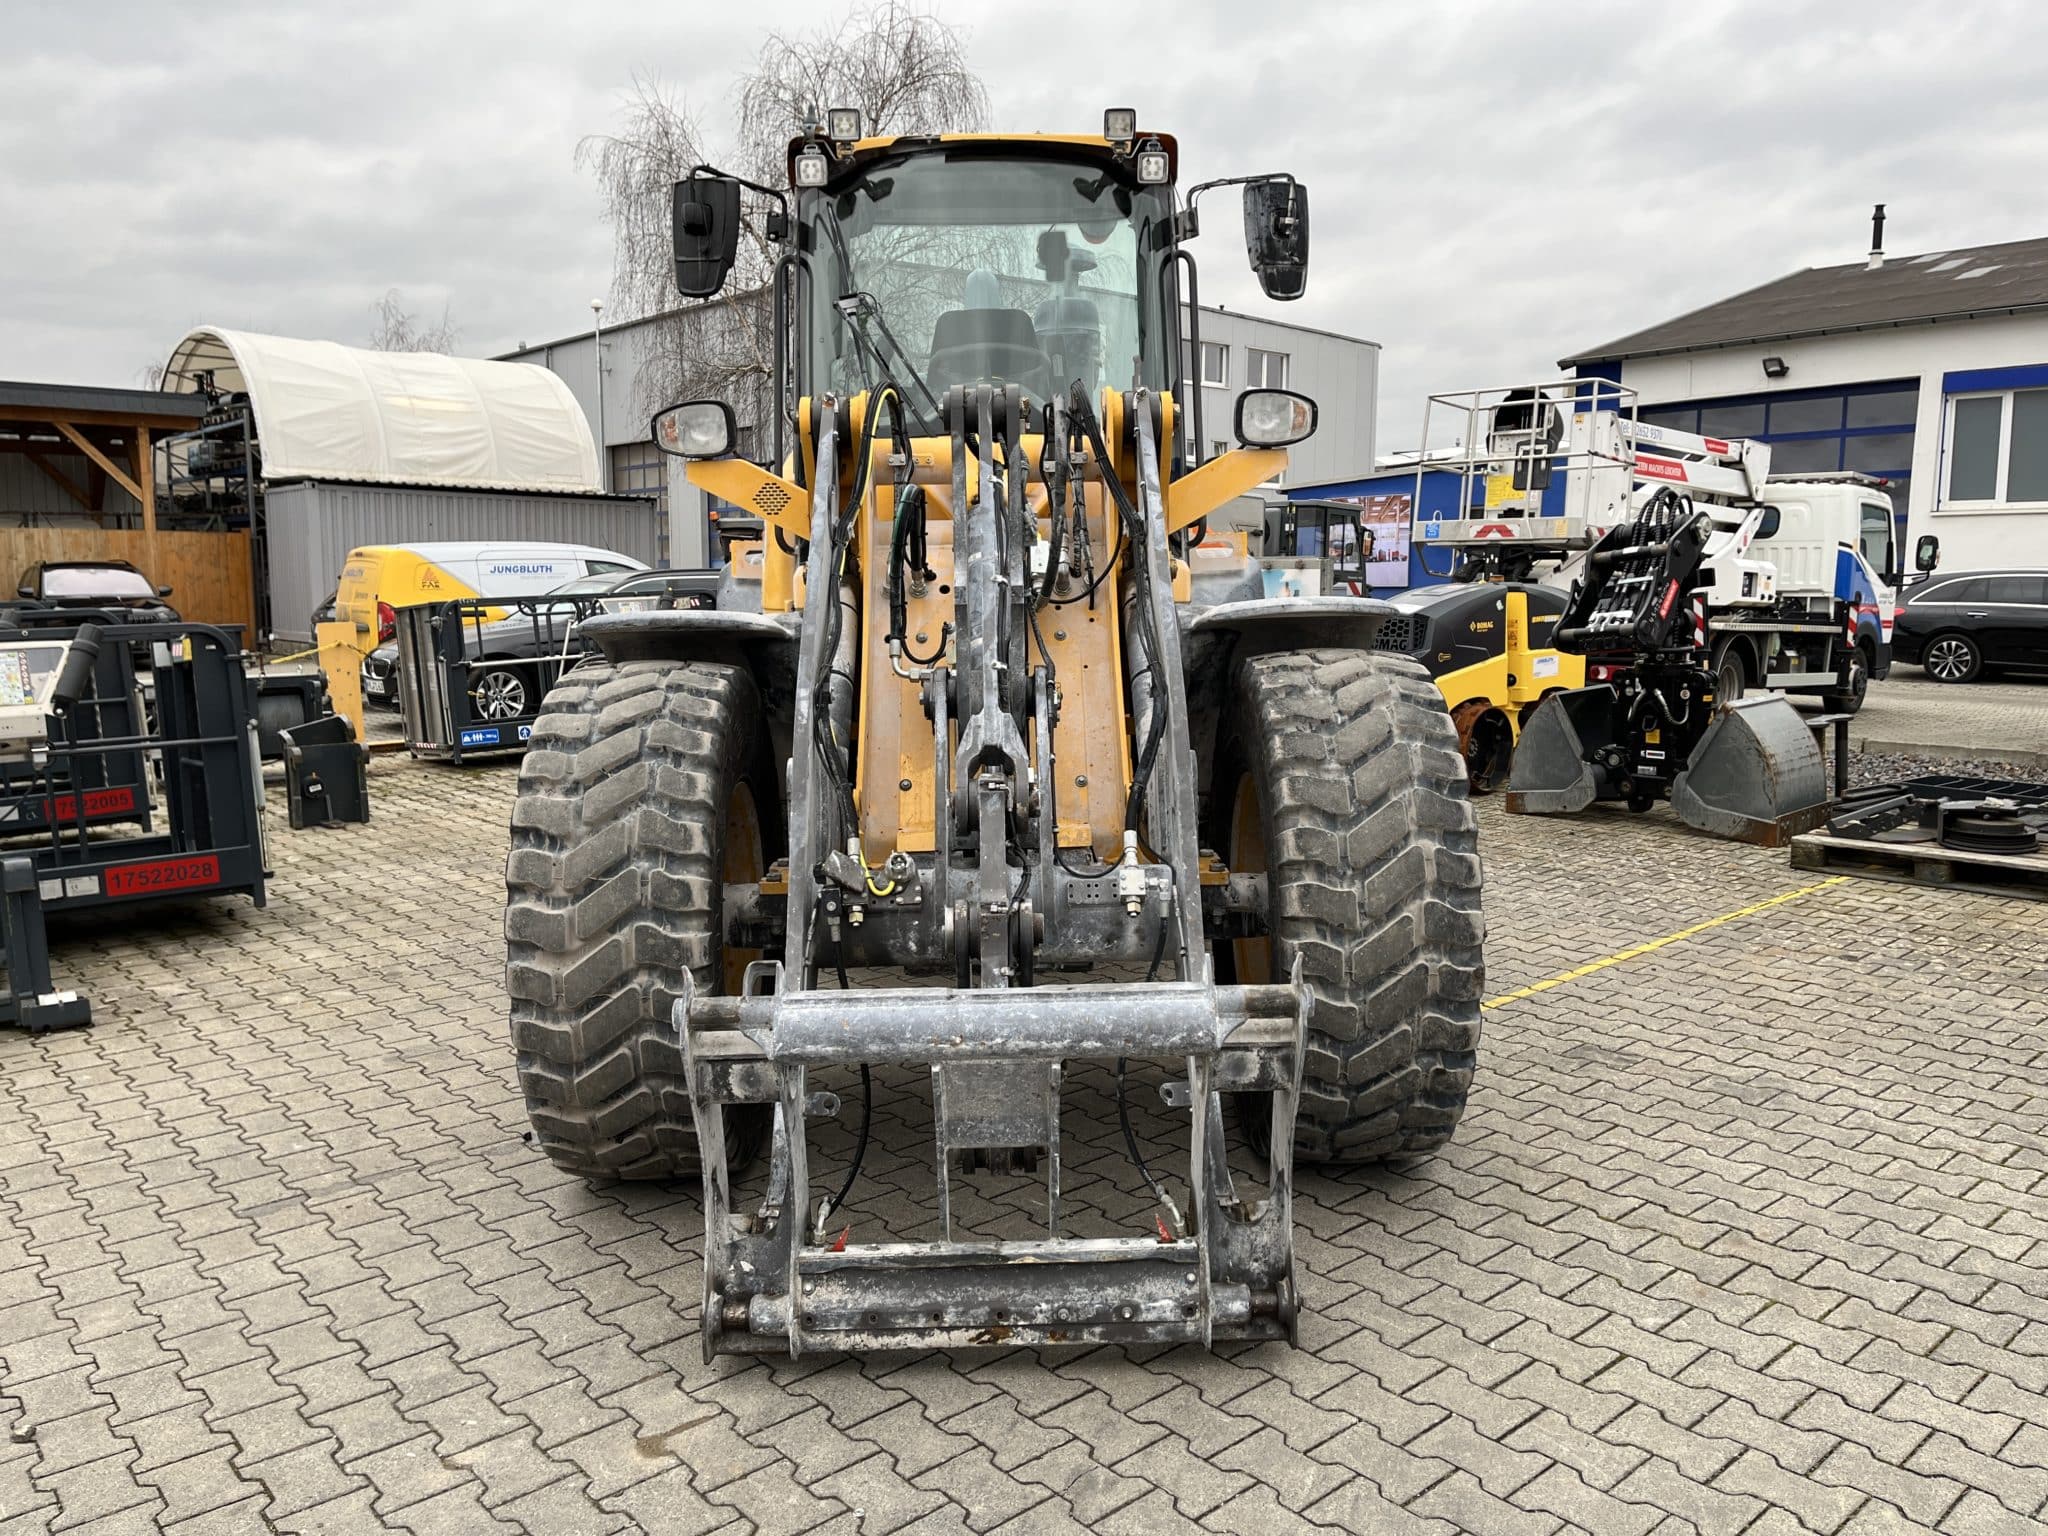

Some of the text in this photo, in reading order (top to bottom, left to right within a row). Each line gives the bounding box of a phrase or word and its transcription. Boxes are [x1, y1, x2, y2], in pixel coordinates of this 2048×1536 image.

[490, 565, 552, 574] JUNGBLUTH
[1371, 637, 1408, 651] OMAG
[56, 793, 129, 816] 7522005
[111, 862, 213, 889] 17522028
